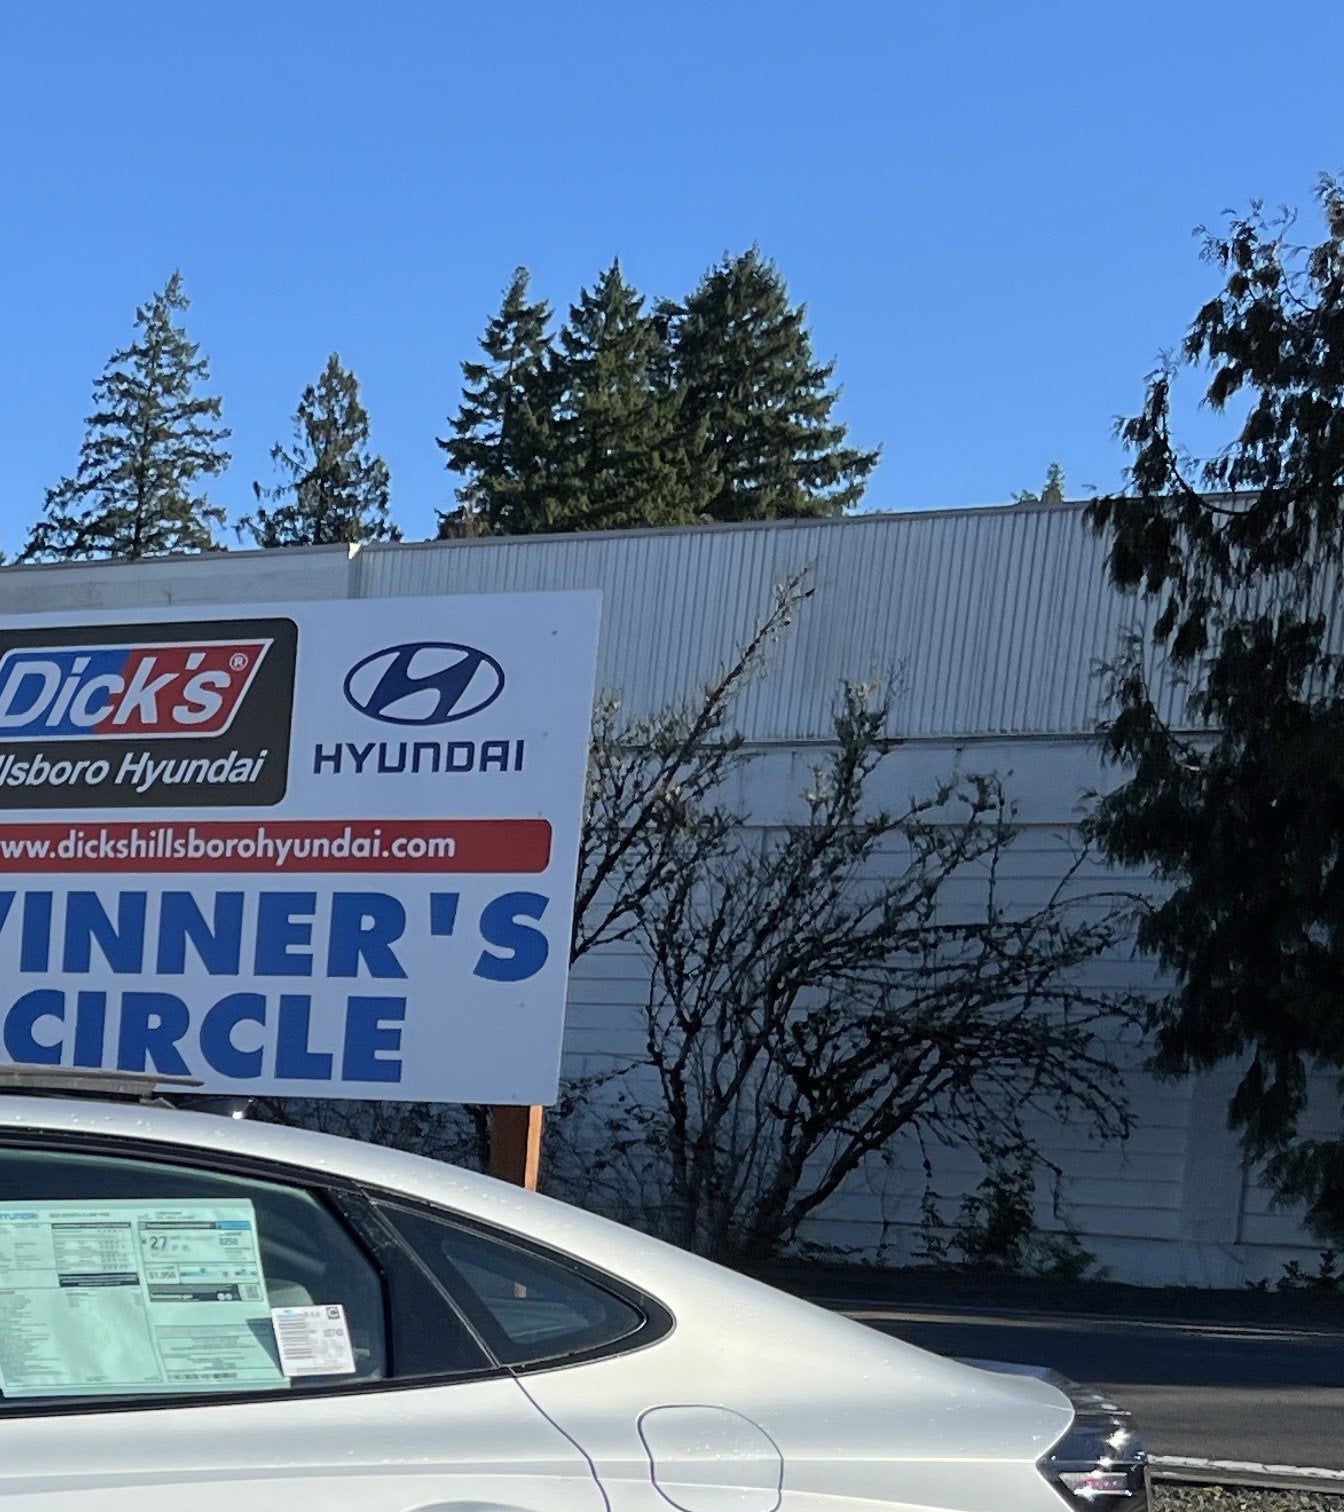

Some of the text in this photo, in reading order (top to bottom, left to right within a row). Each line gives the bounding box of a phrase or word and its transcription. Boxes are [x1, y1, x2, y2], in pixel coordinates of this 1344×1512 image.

[115, 750, 268, 793] Hyundai
[313, 739, 525, 775] HYUNDAI
[3, 988, 408, 1083] CIRCLE
